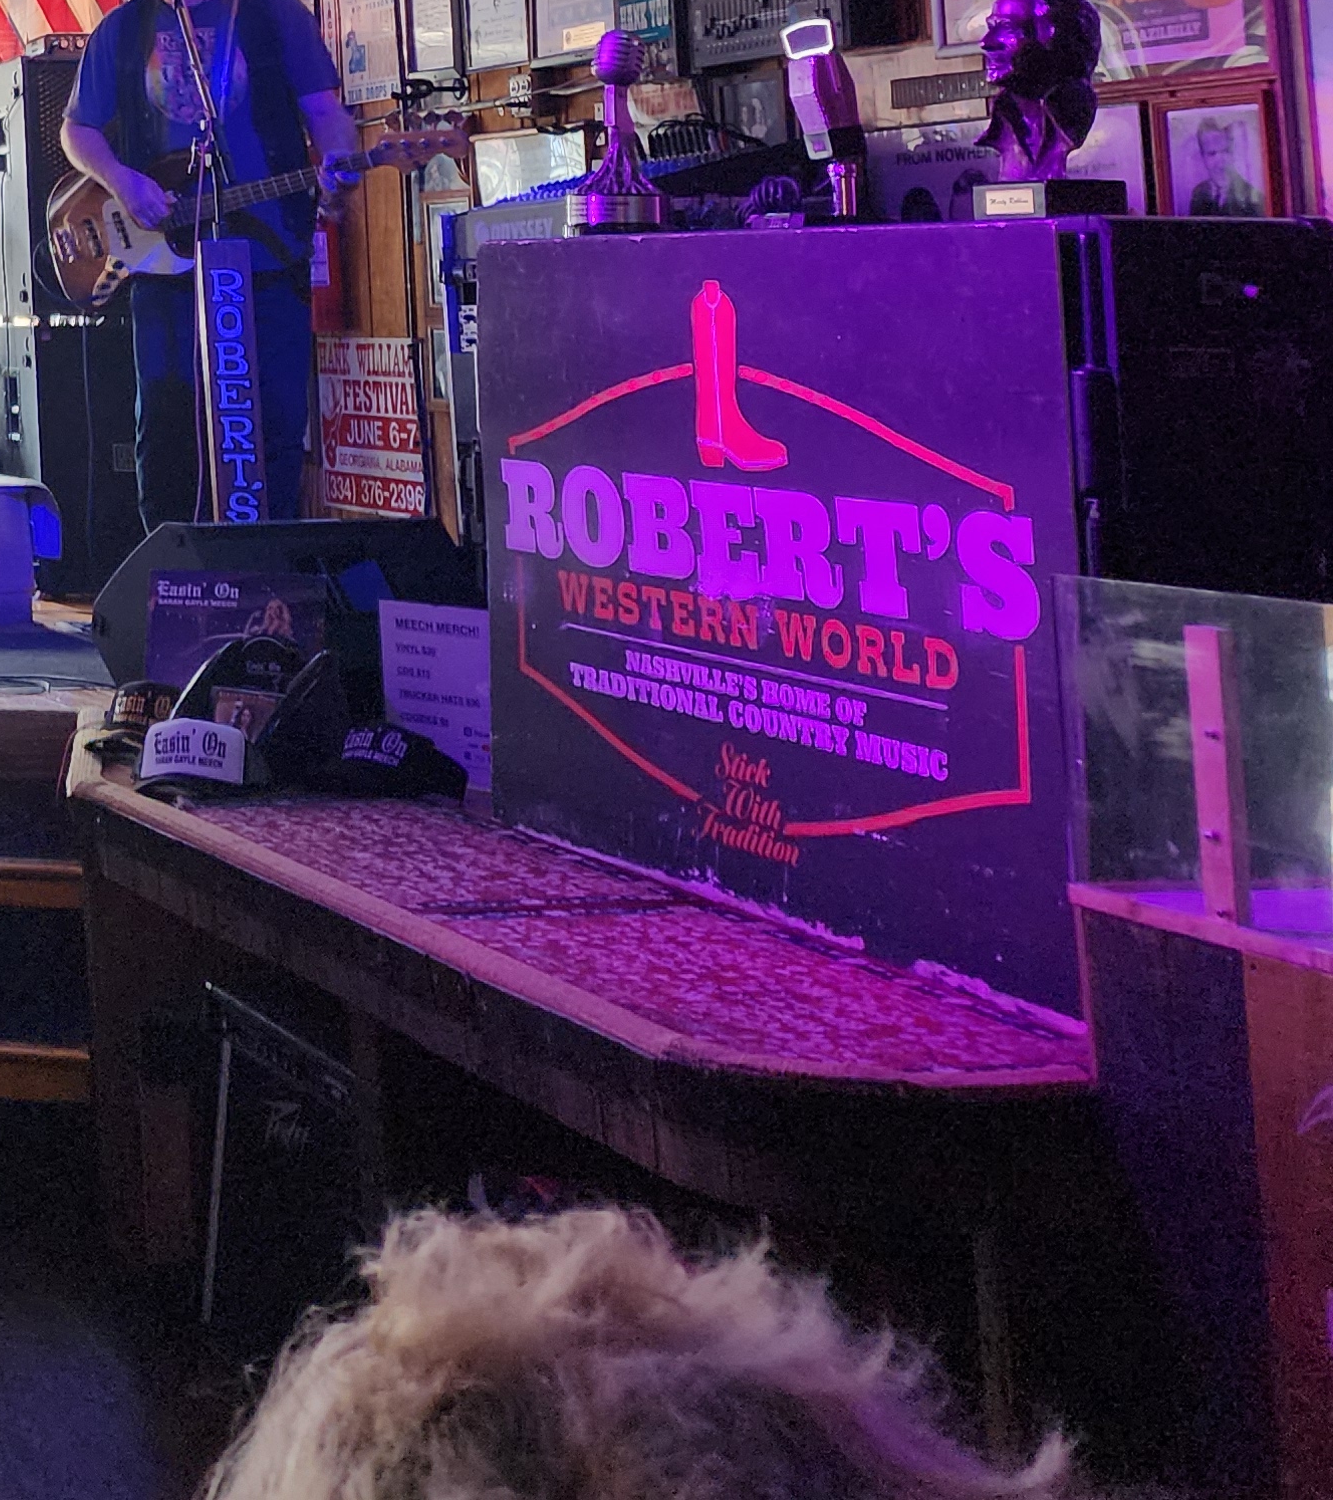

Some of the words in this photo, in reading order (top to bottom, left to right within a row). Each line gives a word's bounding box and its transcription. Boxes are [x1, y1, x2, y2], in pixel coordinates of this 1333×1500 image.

[896, 150, 933, 167] FROM
[492, 218, 553, 241] ODYSSEY
[319, 342, 351, 376] HANK
[210, 268, 260, 524] ROBERT'S
[347, 418, 384, 447] JUNE
[388, 420, 418, 450] 6-7
[385, 457, 423, 473] ALABAMA
[326, 474, 357, 504] (334)
[360, 477, 425, 512] 376-2396
[500, 457, 1041, 642] ROBERT'S
[214, 582, 240, 600] On
[395, 617, 434, 633] MEECH
[435, 621, 481, 639] MERCH!
[557, 570, 759, 651] WESTERN
[774, 609, 960, 691] WORLD
[624, 649, 759, 702] NASHVILLE'S
[761, 673, 832, 719] HOME
[834, 697, 868, 728] OF
[568, 662, 724, 723] TRADITIONAL
[728, 699, 849, 756] COUNTRY
[854, 730, 949, 782] MUSIC
[153, 727, 197, 756] Easin'
[201, 729, 228, 760] On
[381, 730, 408, 759] On
[716, 741, 772, 789] Stick
[720, 781, 783, 826] With
[692, 803, 801, 867] Tradition
